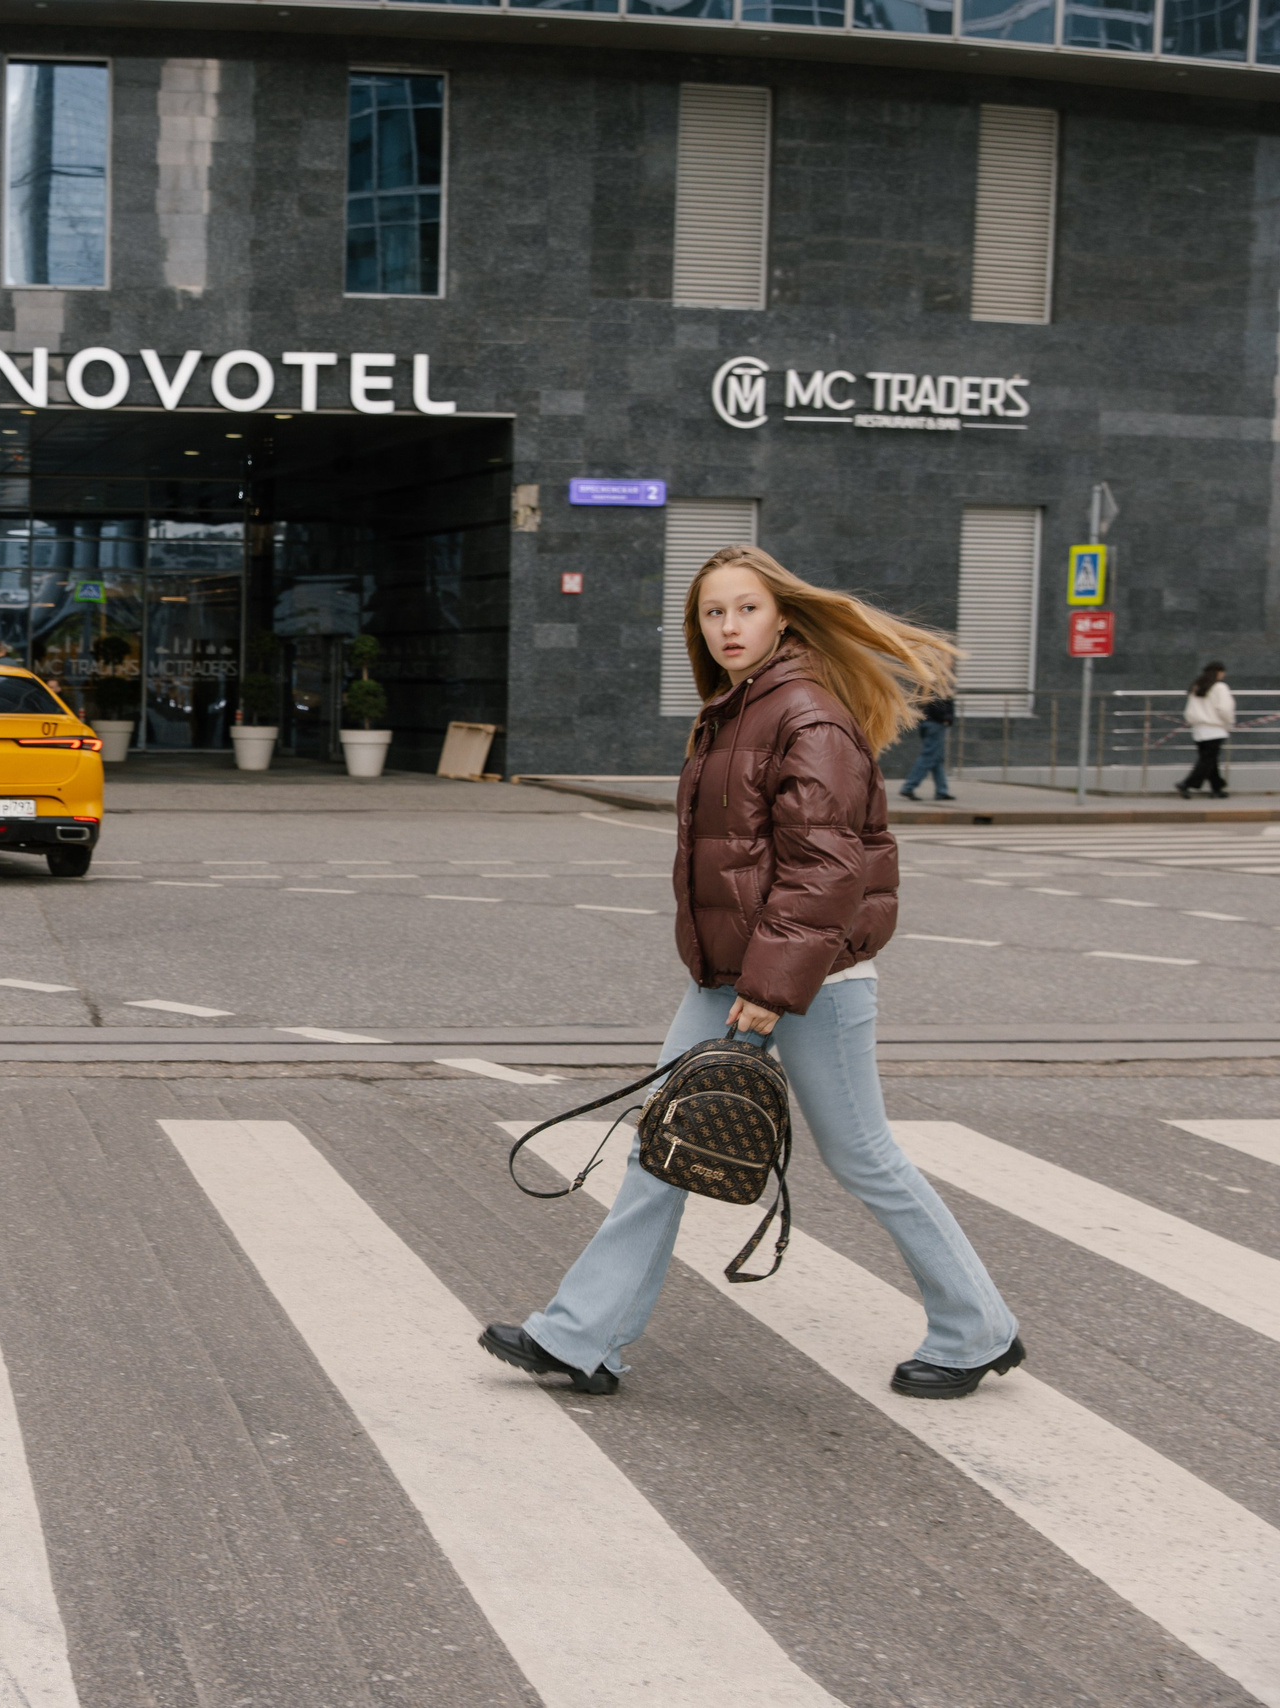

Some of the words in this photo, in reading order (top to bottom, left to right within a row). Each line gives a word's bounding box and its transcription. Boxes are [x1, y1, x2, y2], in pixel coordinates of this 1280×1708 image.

[785, 369, 857, 411] MC
[866, 371, 1031, 418] TRADERS
[646, 485, 659, 500] 2
[34, 659, 63, 676] MC
[689, 1164, 726, 1181] GUESS
